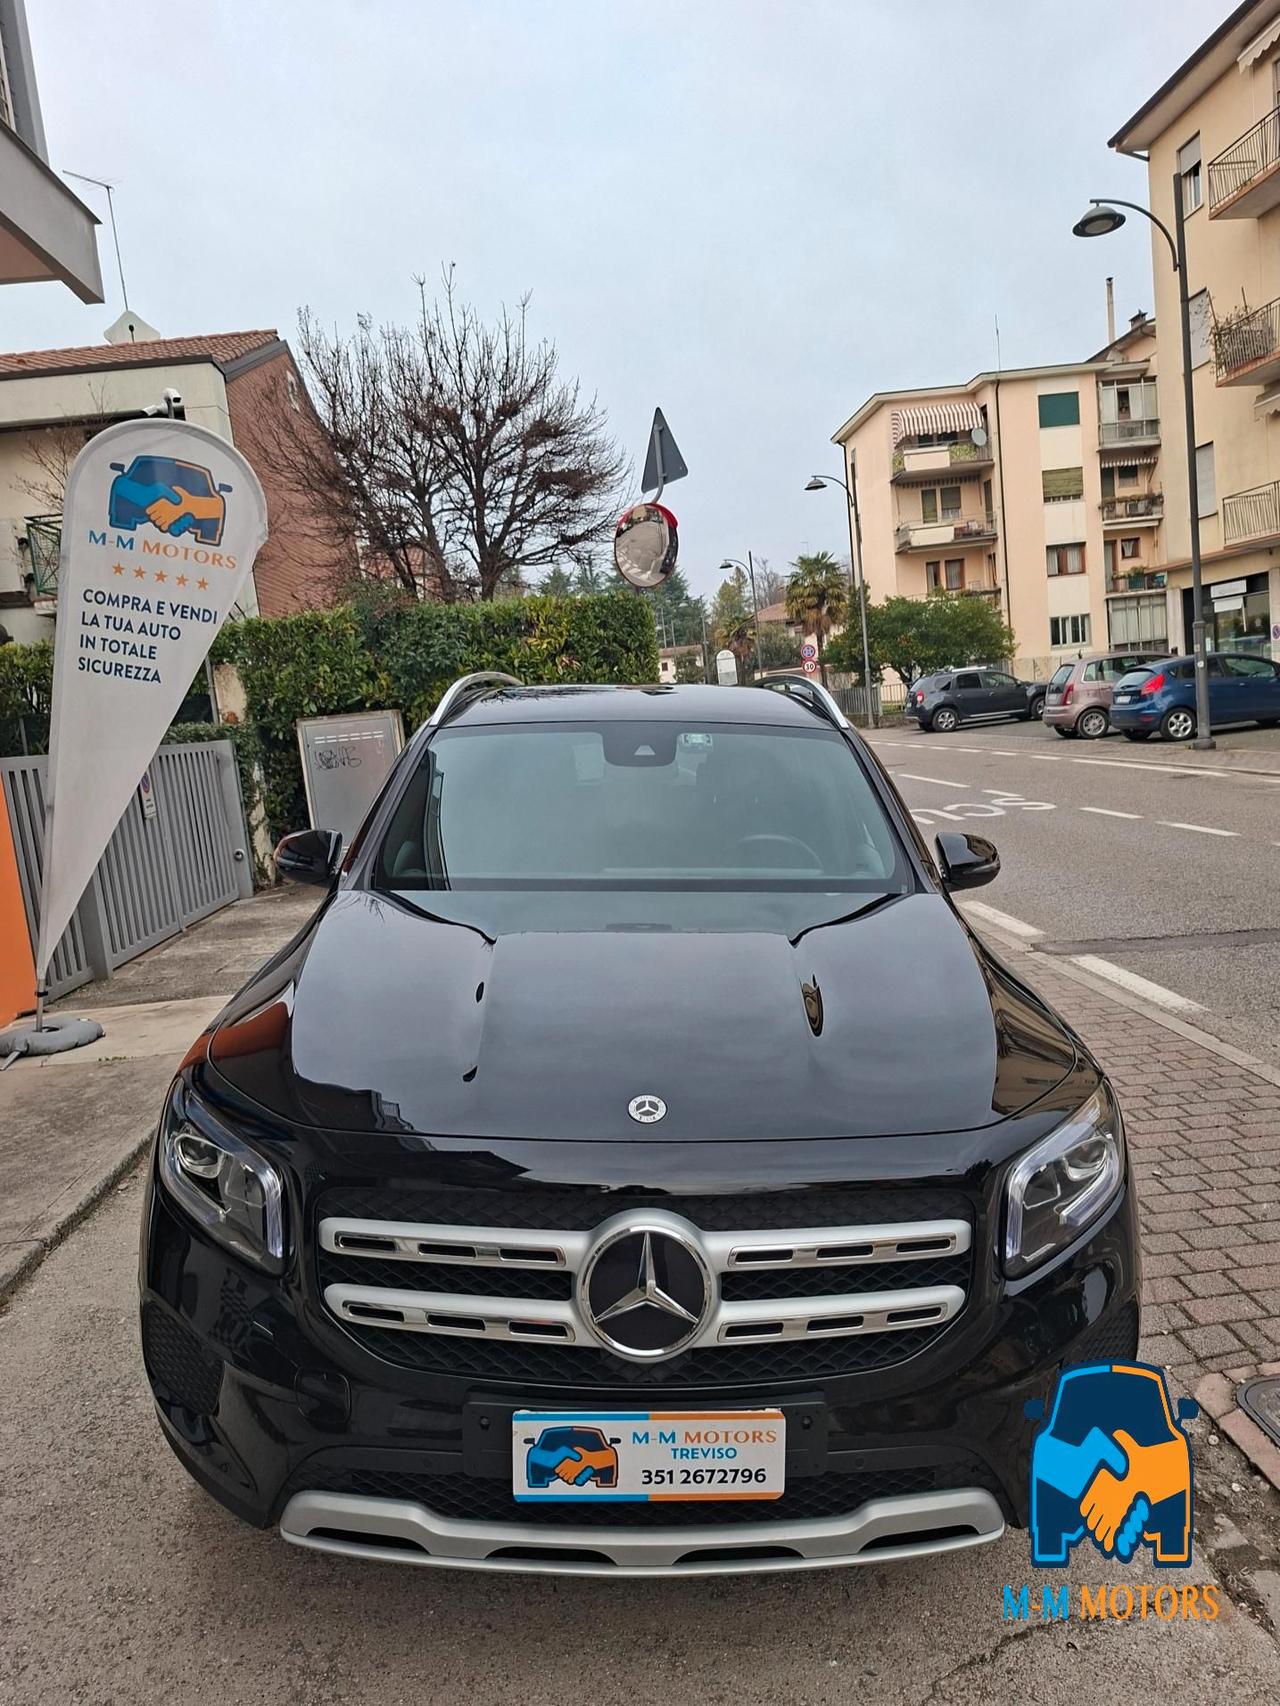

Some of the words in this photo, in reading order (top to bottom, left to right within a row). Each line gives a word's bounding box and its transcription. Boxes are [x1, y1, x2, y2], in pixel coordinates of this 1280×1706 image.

[88, 529, 135, 551] M-M
[143, 539, 238, 570] MOTORS
[83, 588, 152, 614] COMPRA
[156, 601, 165, 615] E
[169, 603, 218, 625] VENDI
[81, 611, 100, 628] LA
[104, 615, 134, 633] TUA
[137, 622, 181, 641] AUTO
[79, 634, 96, 650] IN
[100, 636, 157, 660] TOTALE
[78, 656, 162, 684] SICUREZZA
[632, 1431, 676, 1444] M-M
[684, 1430, 777, 1444] MOTORS
[671, 1447, 738, 1460] TREVISO
[641, 1469, 674, 1485] 351
[680, 1468, 767, 1485] 2672796
